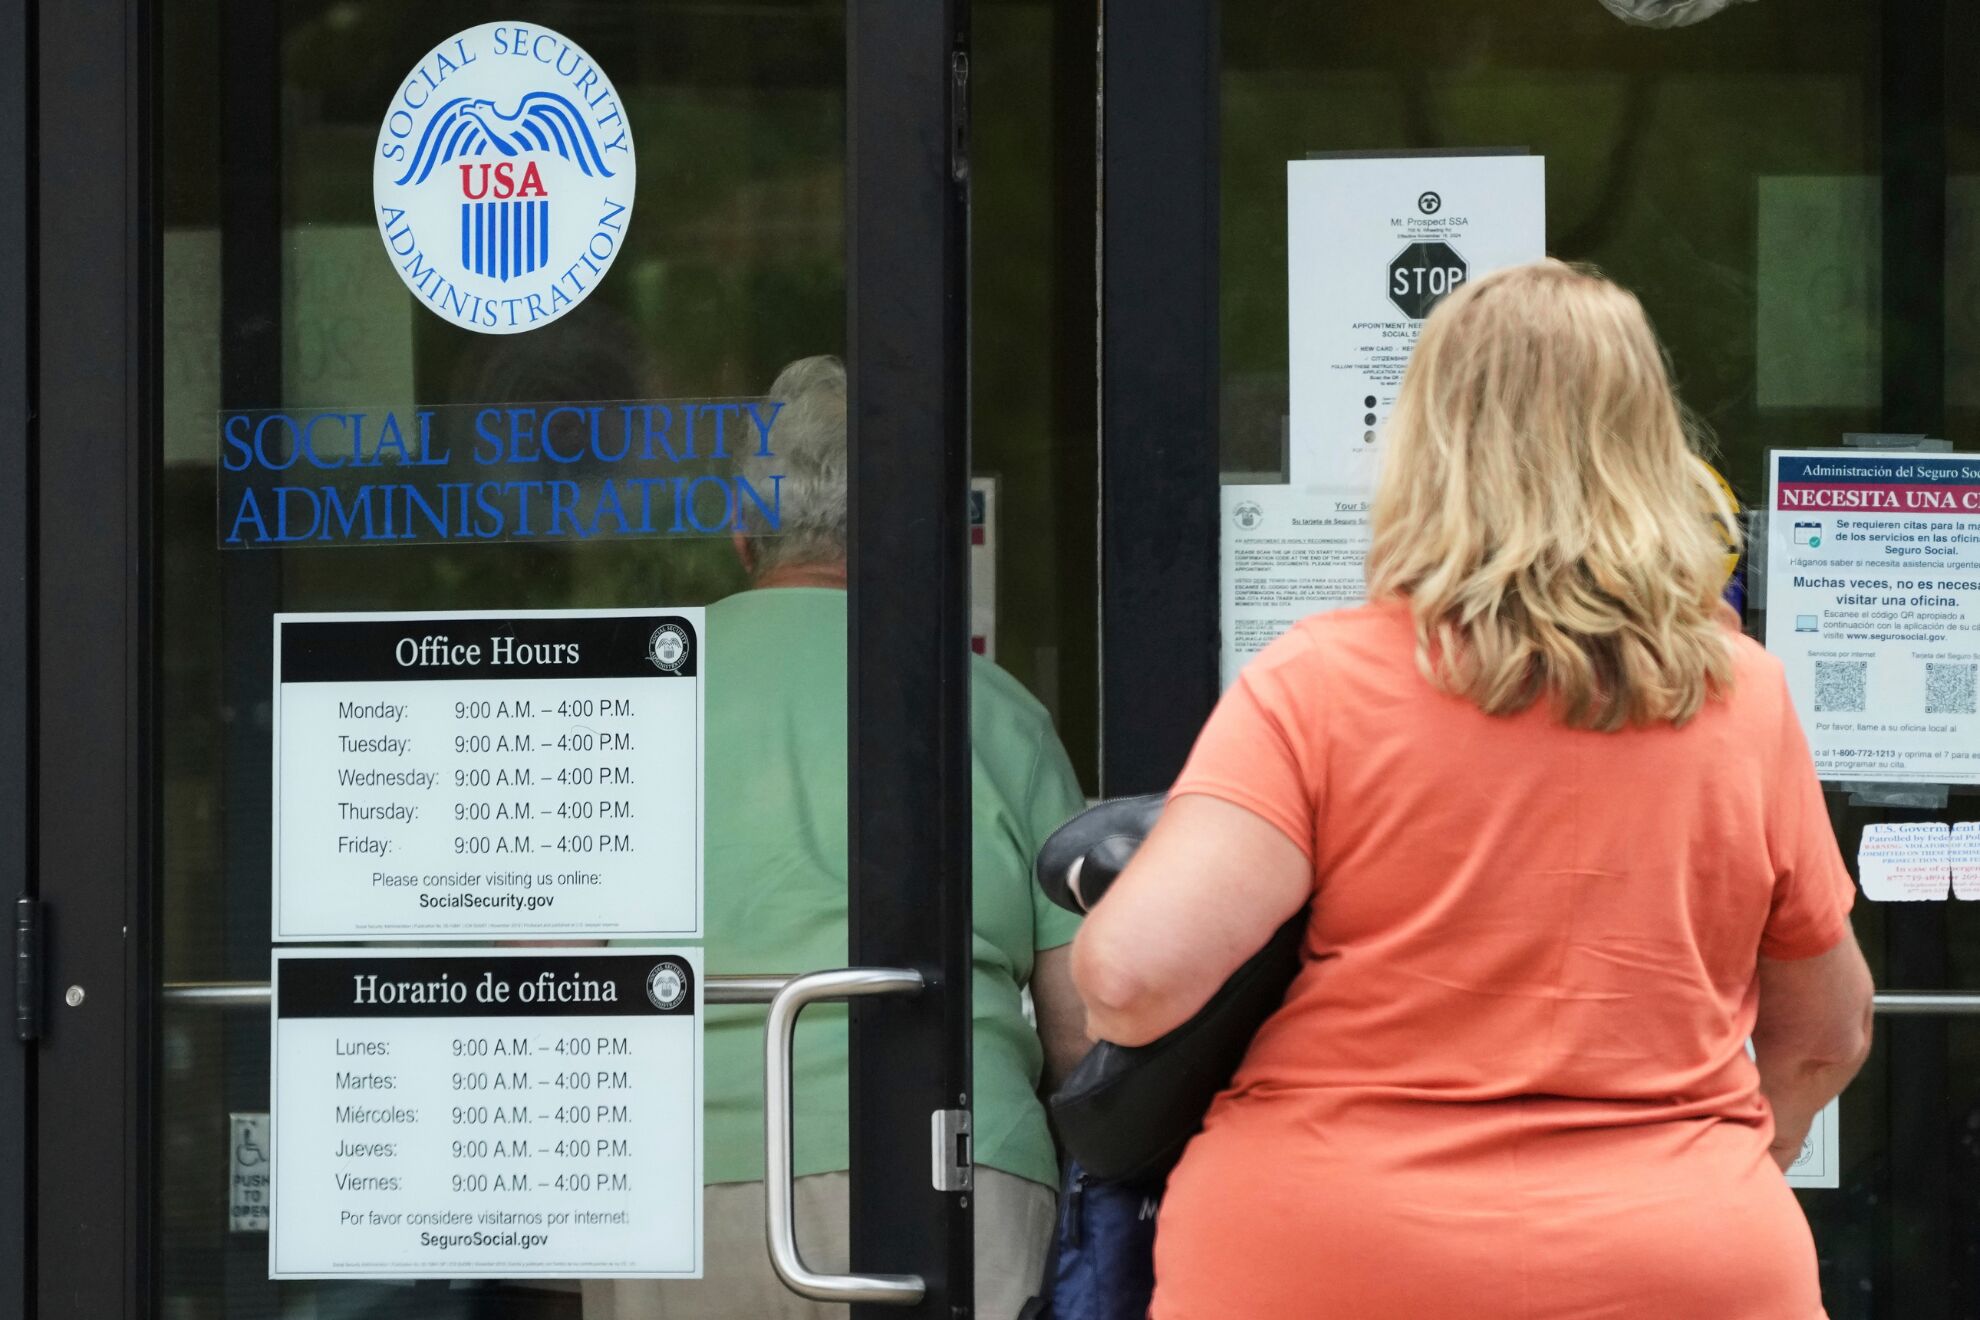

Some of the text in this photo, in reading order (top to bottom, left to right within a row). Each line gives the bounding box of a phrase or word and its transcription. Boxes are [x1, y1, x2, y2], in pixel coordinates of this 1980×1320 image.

[382, 27, 628, 163] SOCIAL SECURITY
[459, 161, 548, 200] USA
[382, 197, 626, 327] ADMINISTRATION
[1394, 267, 1464, 296] STOP
[1382, 330, 1410, 338] SOCIAL
[222, 402, 784, 472] SOCIAL SECURITY
[1802, 464, 1892, 477] Administración
[1895, 465, 1912, 477] del
[1917, 466, 1958, 481] Seguro
[1783, 489, 1957, 508] NECESITA UNA
[225, 475, 786, 543] ADMINISTRATION
[1836, 519, 1964, 531] Se requieren citas para la
[1835, 532, 1847, 540] de
[1850, 532, 1866, 541] los
[1868, 532, 1914, 541] servicios
[1933, 533, 1947, 542] las
[1885, 545, 1958, 556] Seguro Social.
[1790, 558, 1827, 567] Háganos
[1830, 559, 1853, 567] saber
[1902, 560, 1944, 568] asistencia
[1793, 576, 1845, 588] Muchas
[1849, 579, 1892, 589] veces,
[1896, 580, 1913, 589] no
[1917, 580, 1933, 590] es
[1836, 594, 1959, 606] visitar una oficina.
[396, 636, 578, 666] Office Hours
[339, 698, 634, 723] Monday: 9:00 A.M. 4:00 P.M.
[1815, 722, 1830, 730] Por
[1856, 723, 1878, 731] llame
[1899, 723, 1926, 732] oficina
[1928, 724, 1947, 732] local
[1949, 724, 1956, 732] al
[338, 732, 634, 757] Tuesday: 9:00 A.M. 4:00 P.M.
[1831, 749, 1895, 757] 1-800-772-1213
[337, 766, 634, 790] Wednesday: 9:00 A.M. 4:00 P.M.
[337, 800, 634, 824] Thursday: 9:00 A.M. 4:00 P.M.
[338, 834, 634, 858] Friday: 9:00 A.M. 4:00 P.M.
[372, 870, 601, 889] Please consider visiting us online:
[419, 892, 553, 911] SocialSecurity.gov
[354, 973, 466, 1003] Horario
[476, 973, 509, 1002] de
[518, 971, 617, 1002] oficina
[336, 1037, 631, 1056] Lunes: 9:00 A.M. 4:00 P.M.
[336, 1071, 631, 1090] Martes: 9:00 A.M. 4:00 P.M.
[336, 1105, 631, 1124] Miércoles: 9:00 A.M. 4:00 P.M.
[335, 1139, 631, 1158] Jueves: 9:00 A.M. 4:00 P.M.
[334, 1172, 630, 1192] Viernes: 9:00 A.M. 4:00 P.M.
[244, 1190, 260, 1202] TO
[340, 1210, 364, 1225] Por
[368, 1210, 402, 1225] favor
[406, 1210, 472, 1225] considere
[477, 1210, 542, 1224] visitarnos
[547, 1212, 570, 1227] por
[420, 1231, 547, 1249] SeguroSocial.gov
